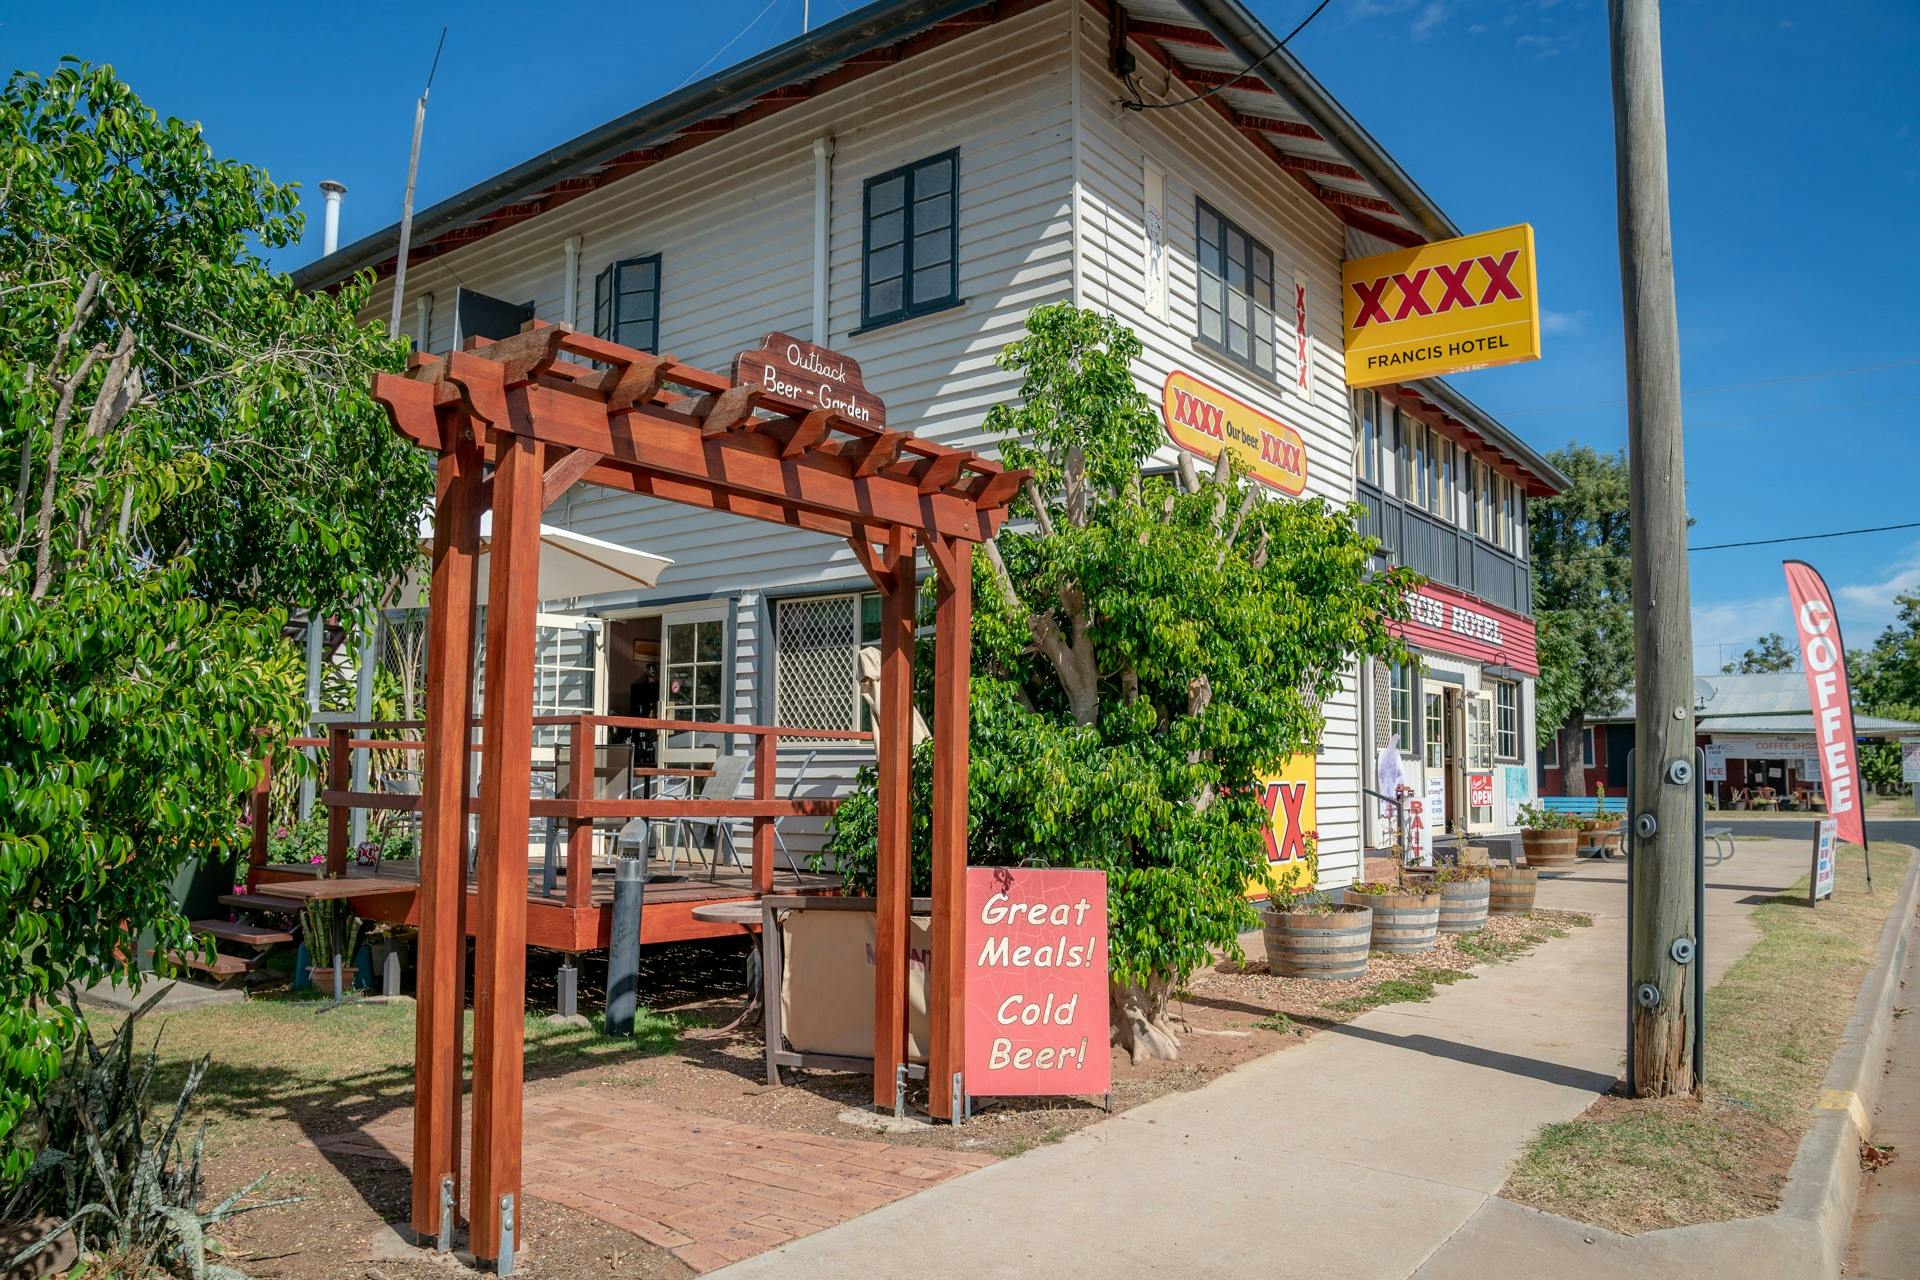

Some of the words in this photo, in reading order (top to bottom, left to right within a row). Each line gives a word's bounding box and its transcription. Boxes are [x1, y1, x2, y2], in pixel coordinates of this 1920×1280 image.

[1350, 248, 1524, 330] XXXX
[787, 343, 846, 384] Outback
[1367, 345, 1443, 369] FRANCIS
[1448, 334, 1509, 356] HOTEL
[763, 365, 802, 399] Beer
[819, 384, 869, 422] Garden
[1172, 386, 1225, 442] XXXX
[1226, 420, 1240, 441] Our
[1260, 429, 1302, 478] XXXX
[1451, 606, 1503, 645] HOTEL
[1801, 600, 1853, 815] COFFEE
[1709, 767, 1723, 775] ICE
[1472, 790, 1492, 804] OPEN
[980, 893, 1091, 925] Great
[977, 935, 1096, 968] Meals!
[996, 992, 1079, 1025] Cold
[988, 1036, 1089, 1070] Beer!
